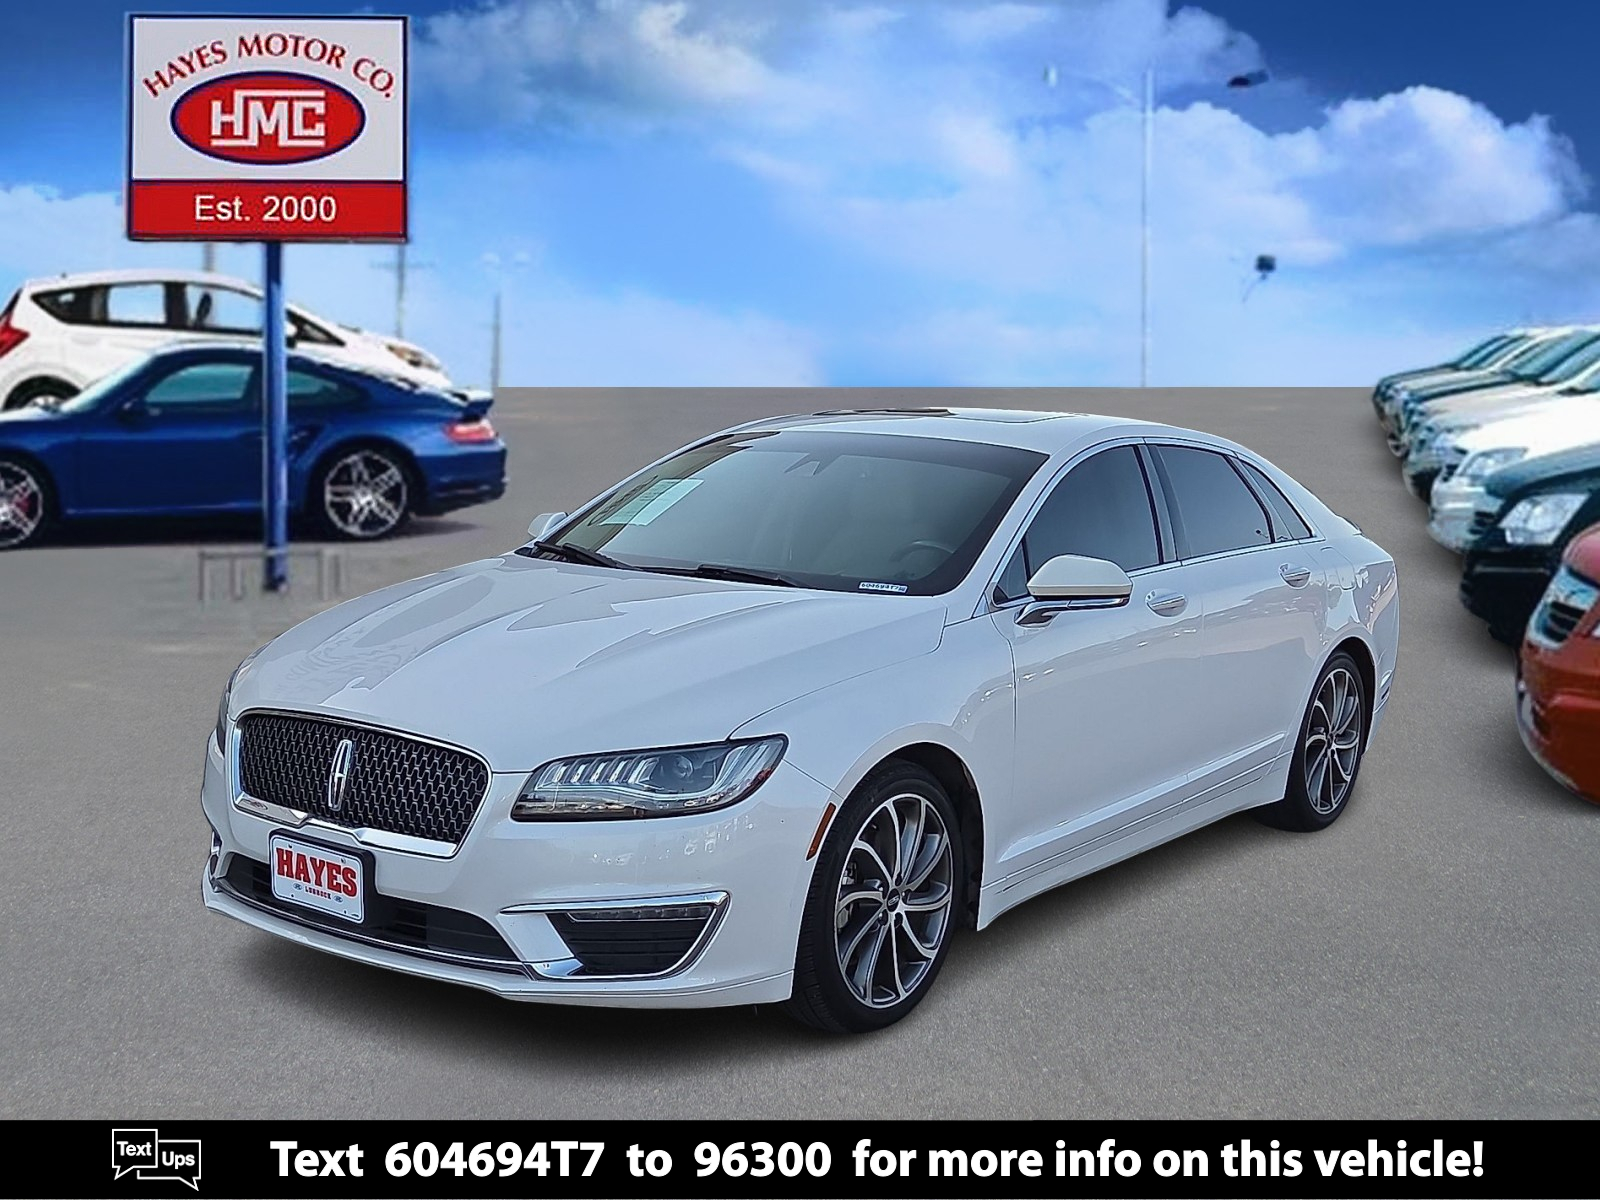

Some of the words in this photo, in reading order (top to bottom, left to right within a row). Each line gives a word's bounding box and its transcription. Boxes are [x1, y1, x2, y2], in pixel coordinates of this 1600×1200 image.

[142, 40, 228, 97] HAYES
[238, 33, 346, 69] MOTOR
[352, 57, 395, 98] CO.
[210, 89, 326, 147] HMC
[195, 195, 250, 221] Est.
[262, 195, 337, 222] 2000
[276, 847, 358, 898] HAYES
